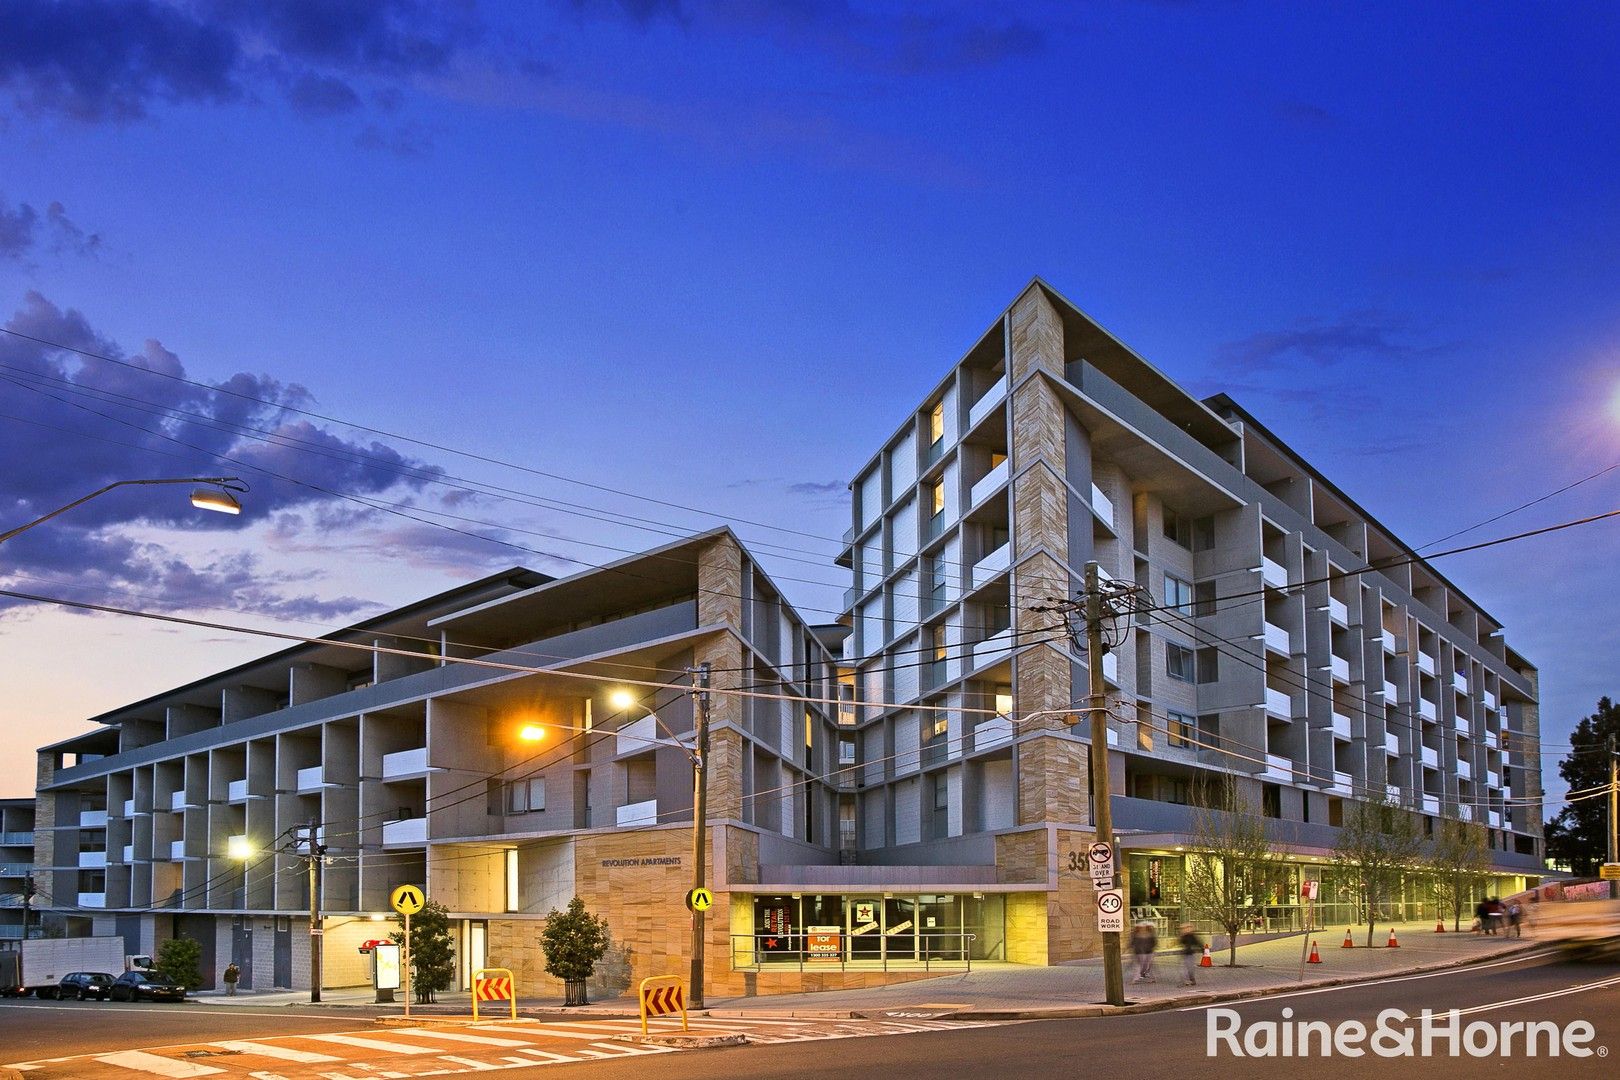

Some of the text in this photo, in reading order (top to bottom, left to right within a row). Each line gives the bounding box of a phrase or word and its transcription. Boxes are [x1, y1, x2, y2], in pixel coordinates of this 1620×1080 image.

[601, 857, 681, 867] REVOLUTION APARTMENTS
[1101, 898, 1119, 909] 40
[810, 943, 838, 951] lease
